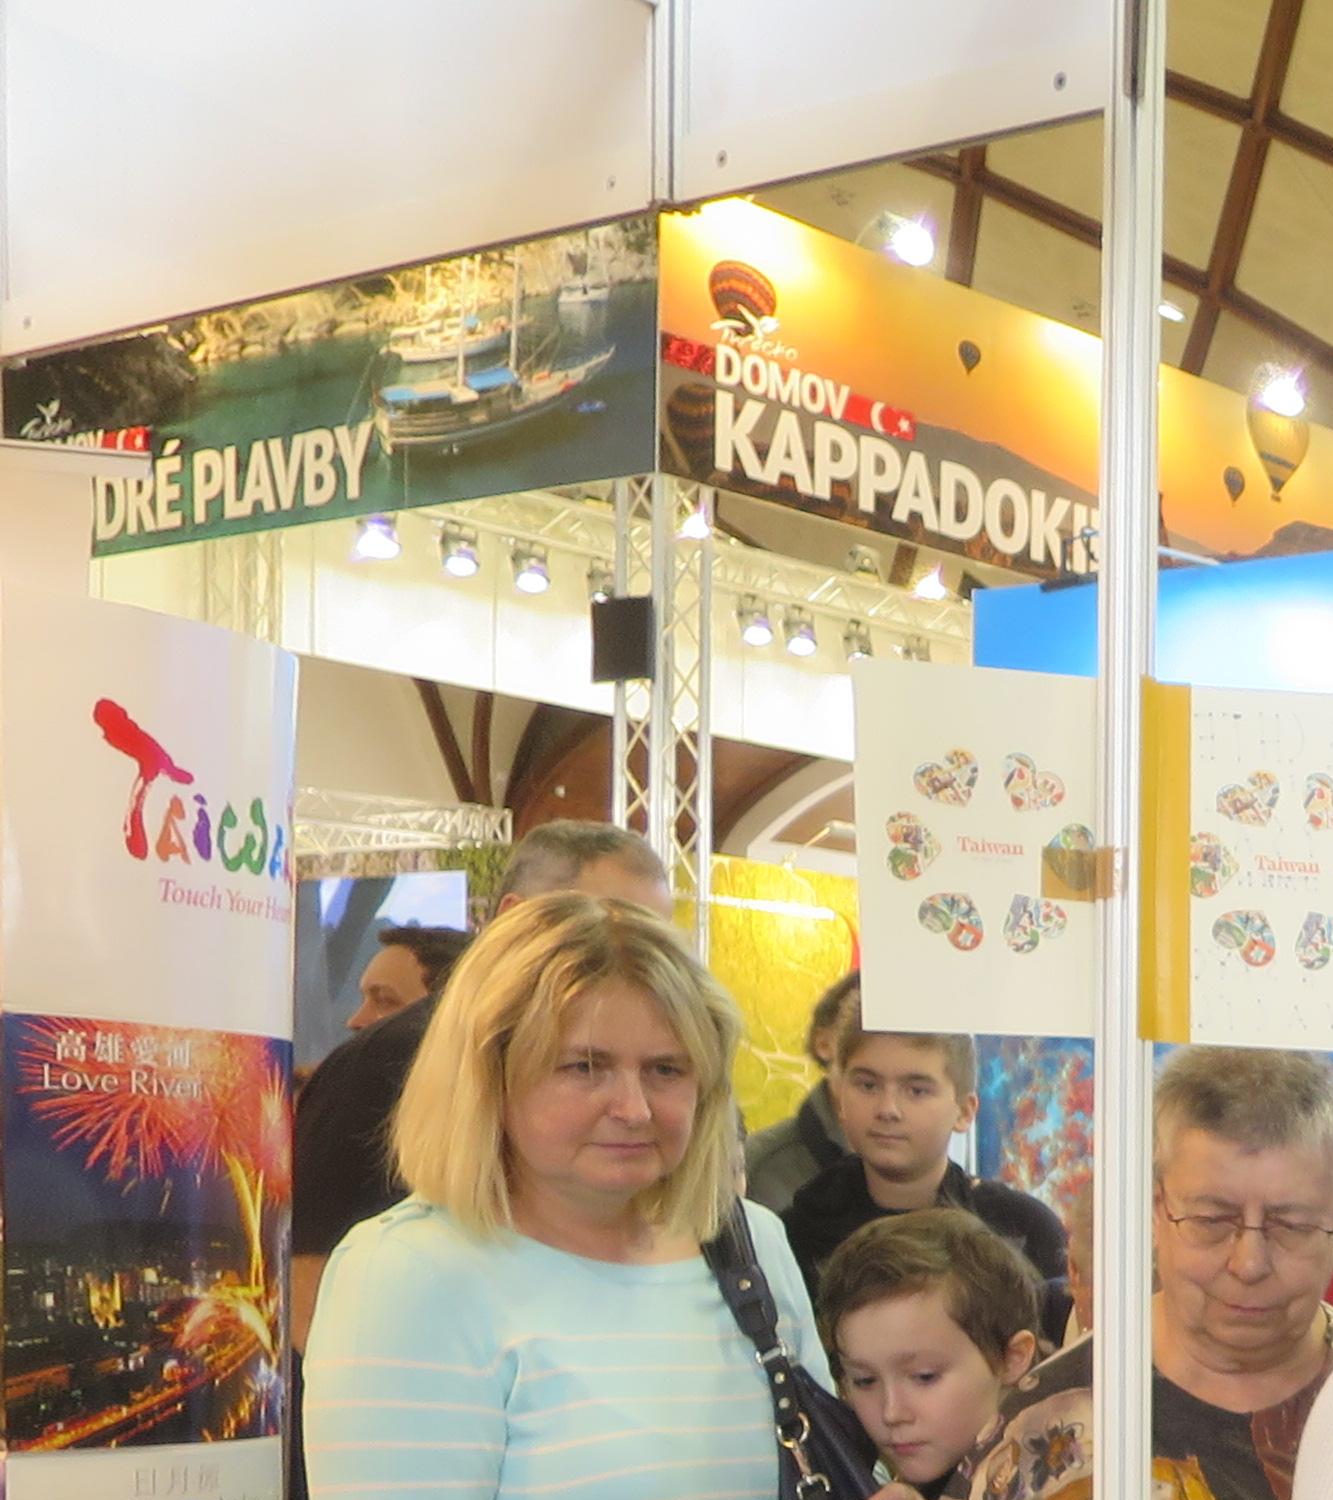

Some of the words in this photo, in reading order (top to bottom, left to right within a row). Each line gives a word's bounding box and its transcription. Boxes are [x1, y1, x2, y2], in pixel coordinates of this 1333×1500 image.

[715, 343, 851, 421] DOMOV
[193, 420, 376, 524] PLAVBY
[955, 834, 1024, 856] Taiwan
[1254, 854, 1320, 875] Taiwan
[159, 877, 222, 910] Touch
[226, 888, 264, 917] Your
[43, 1063, 119, 1093] Love
[131, 1068, 203, 1099] River
